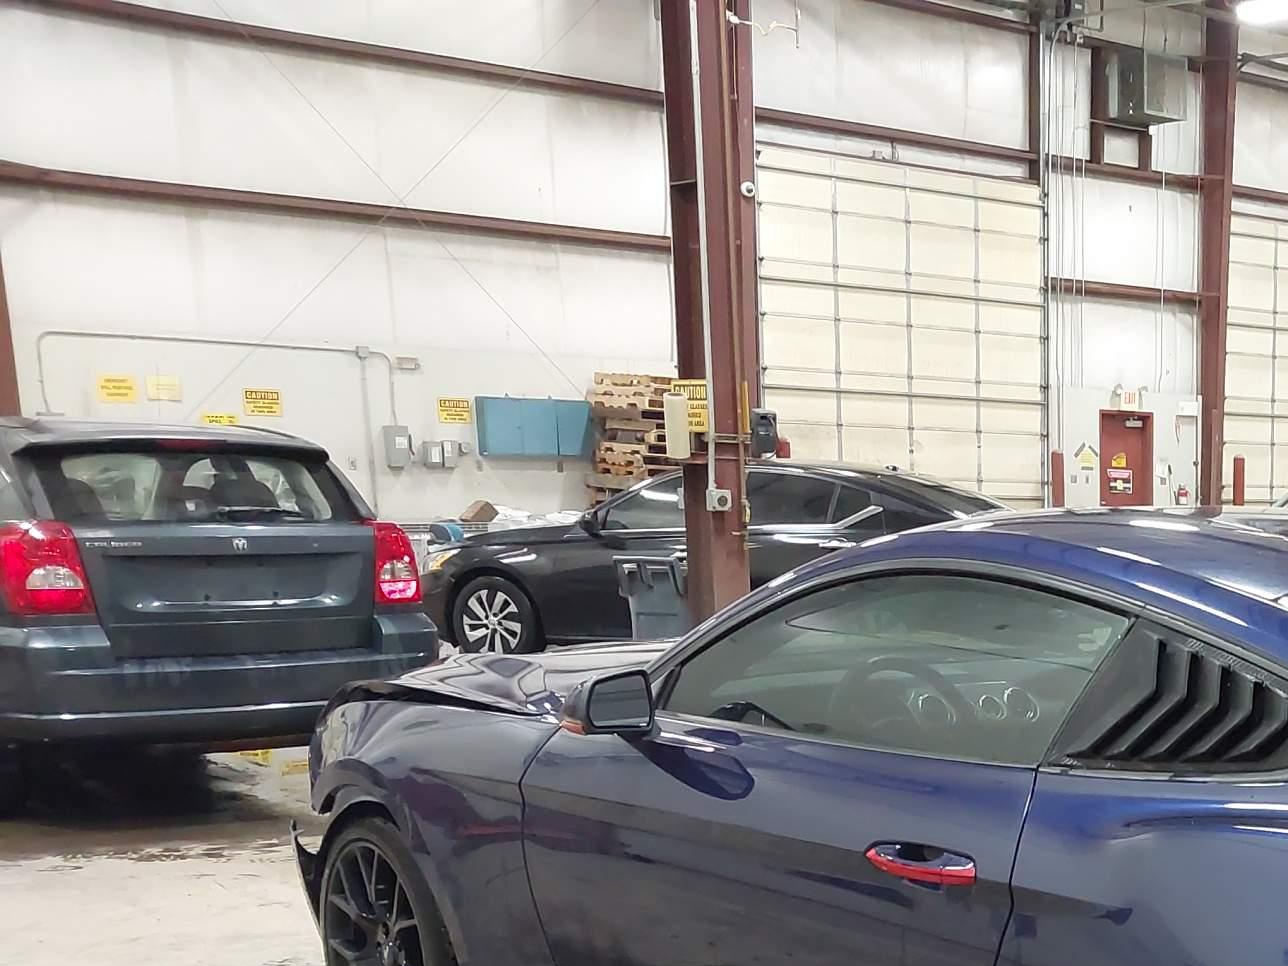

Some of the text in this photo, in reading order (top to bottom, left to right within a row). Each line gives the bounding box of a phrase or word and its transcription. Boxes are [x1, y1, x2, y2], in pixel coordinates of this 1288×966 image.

[246, 391, 279, 400] CAUTION
[1124, 391, 1136, 404] EXIT
[440, 400, 469, 408] CAUTION
